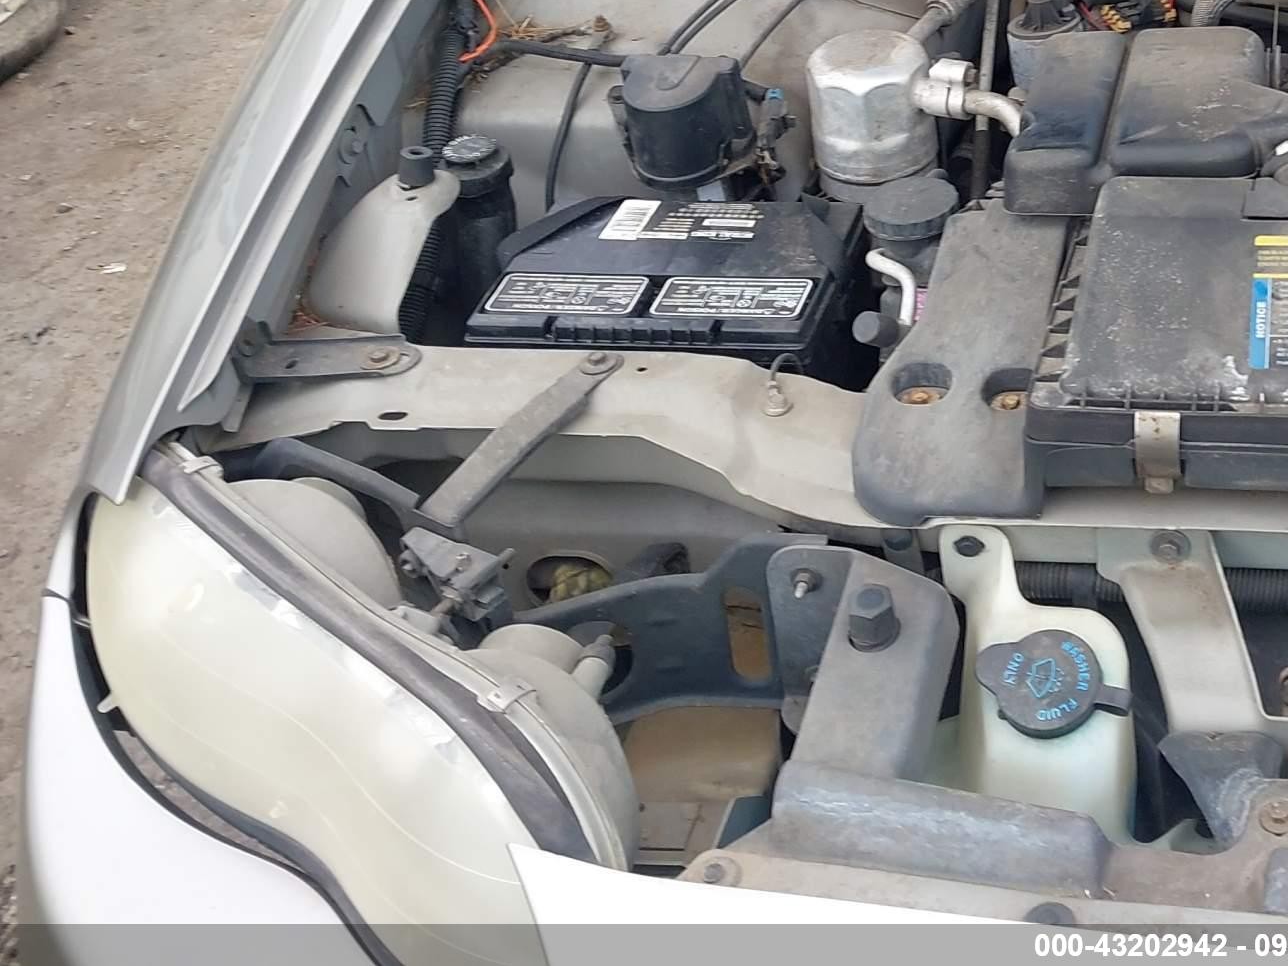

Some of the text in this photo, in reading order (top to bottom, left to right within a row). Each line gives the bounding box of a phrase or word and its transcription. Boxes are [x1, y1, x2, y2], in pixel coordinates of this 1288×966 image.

[1255, 300, 1267, 339] NOTICE
[1003, 653, 1024, 687] ONLY
[1035, 698, 1079, 722] FLUID
